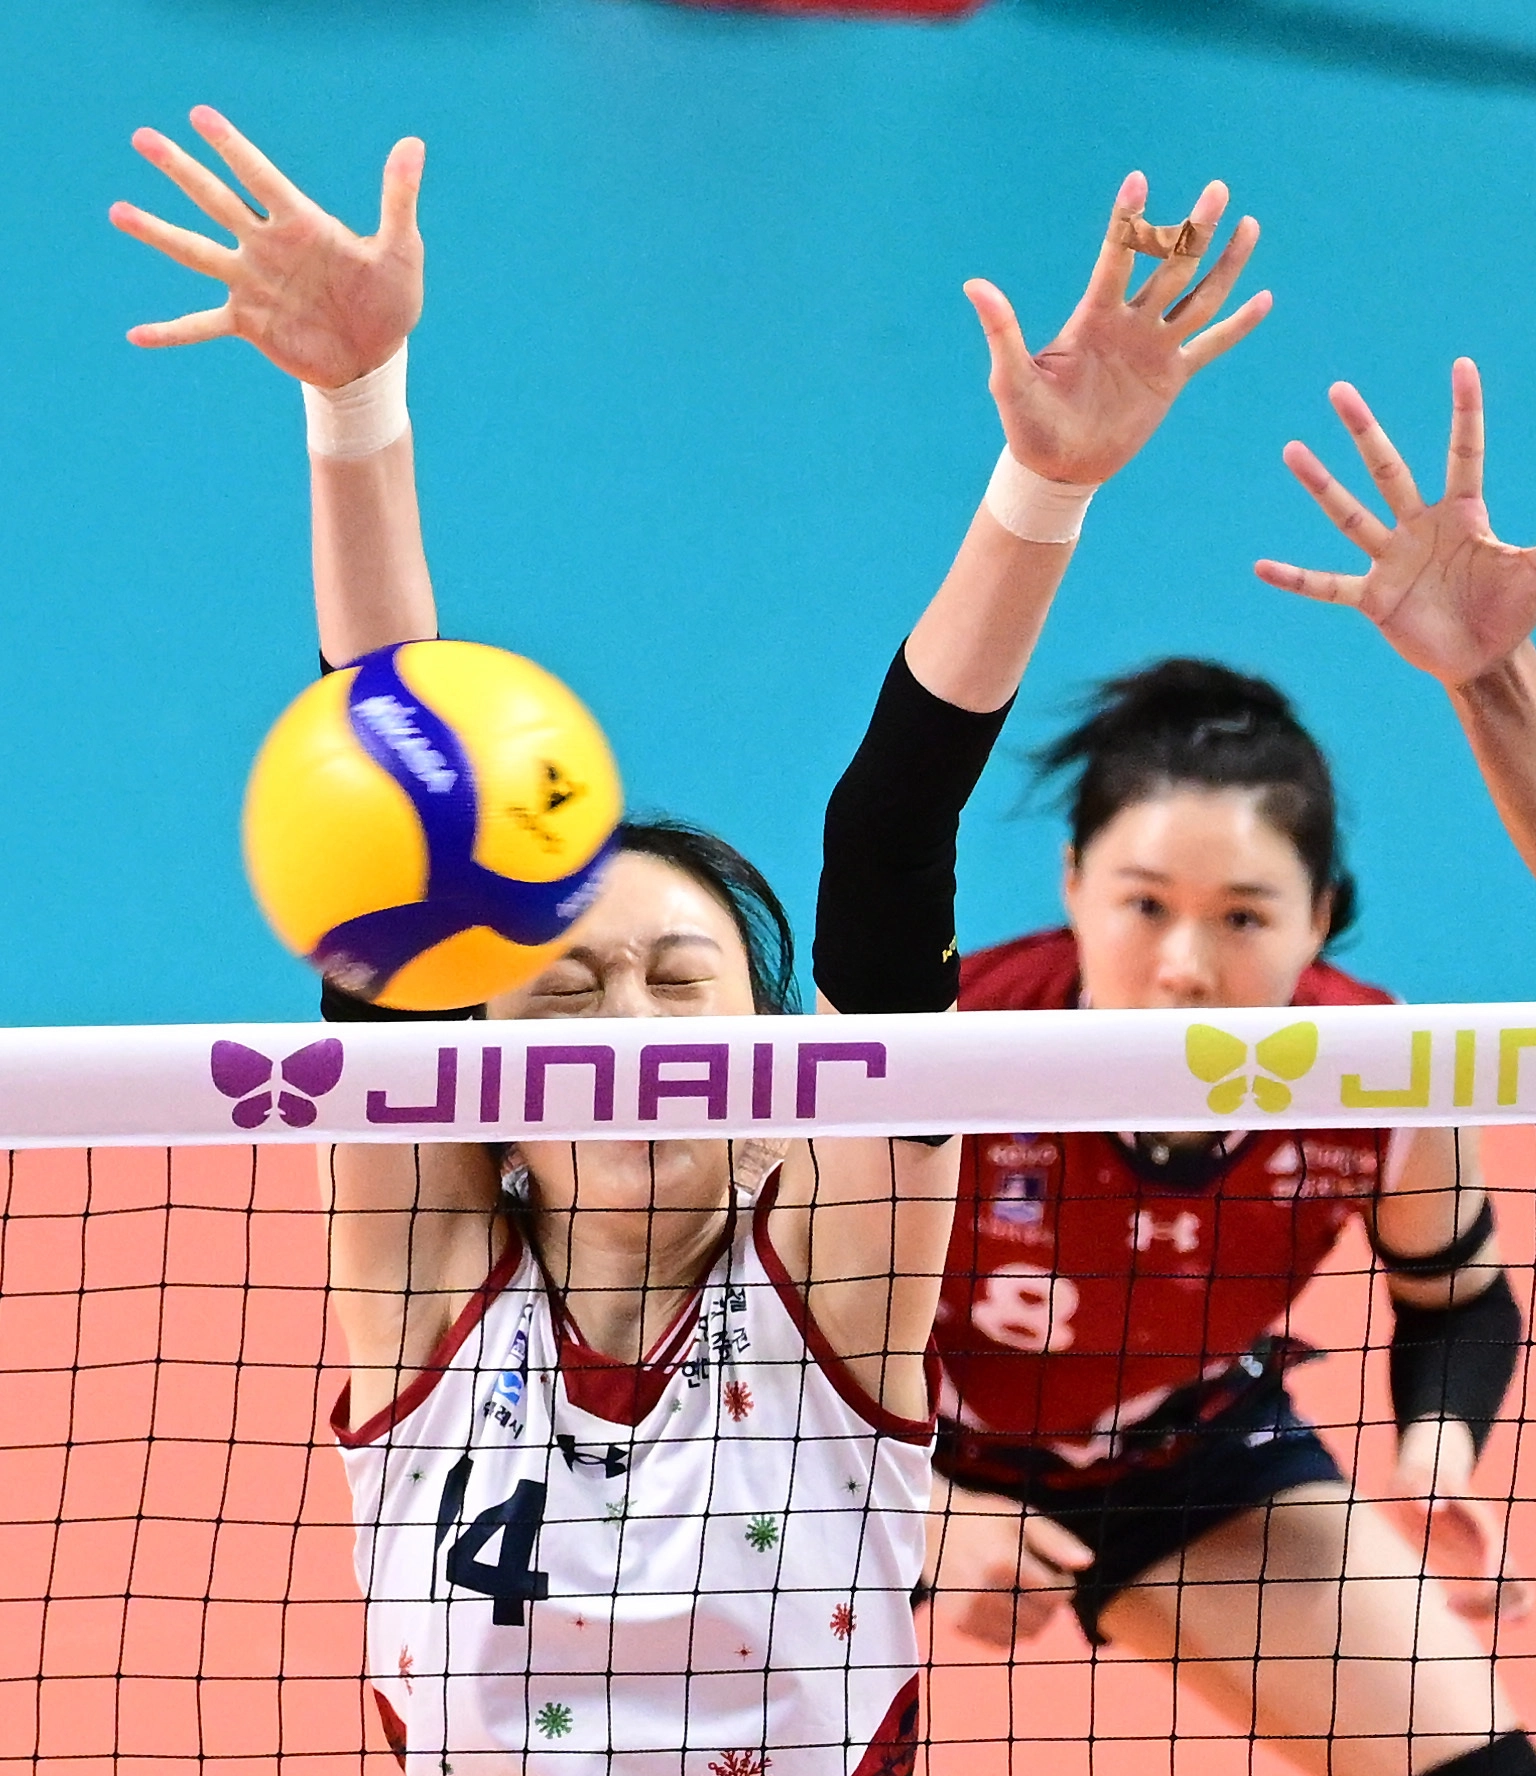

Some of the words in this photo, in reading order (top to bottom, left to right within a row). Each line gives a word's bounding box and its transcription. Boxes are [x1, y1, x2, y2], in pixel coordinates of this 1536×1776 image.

[366, 1042, 886, 1124] JINAIR
[971, 1262, 1079, 1354] 8
[430, 1453, 549, 1627] 14
